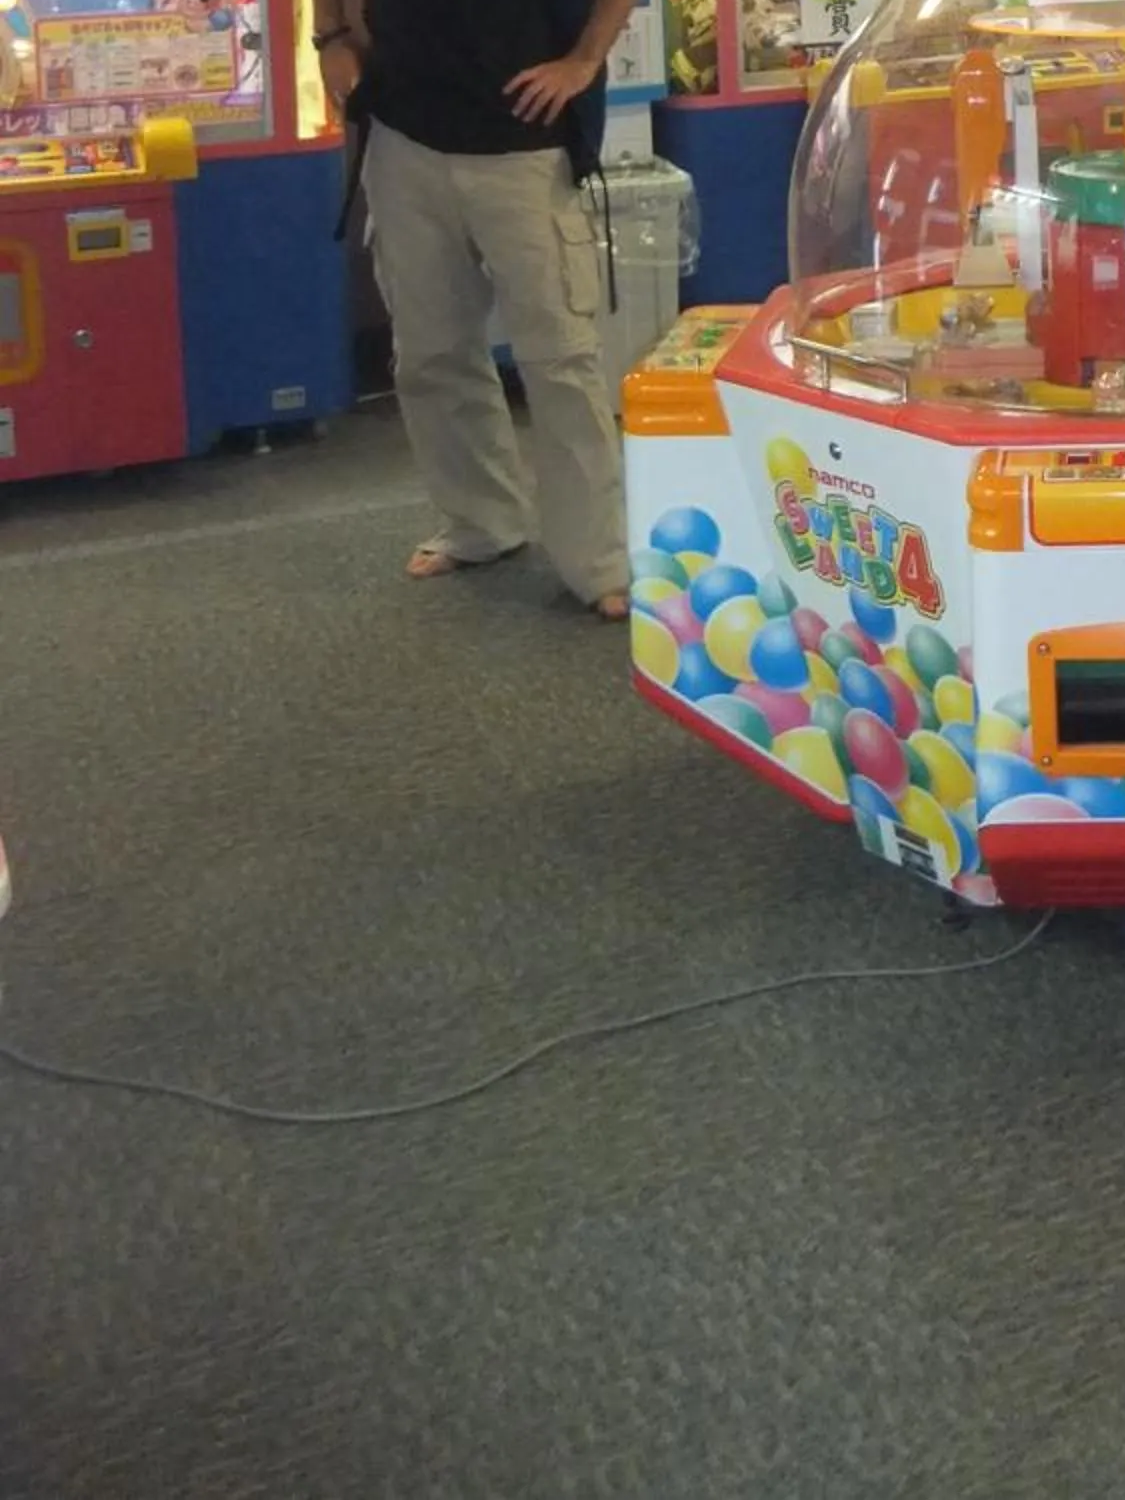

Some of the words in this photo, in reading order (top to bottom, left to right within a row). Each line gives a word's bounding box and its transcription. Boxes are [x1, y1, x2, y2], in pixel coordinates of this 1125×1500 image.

[807, 466, 876, 500] namco
[773, 512, 902, 608] LAND
[775, 480, 902, 564] SWEET
[896, 521, 946, 620] 4
